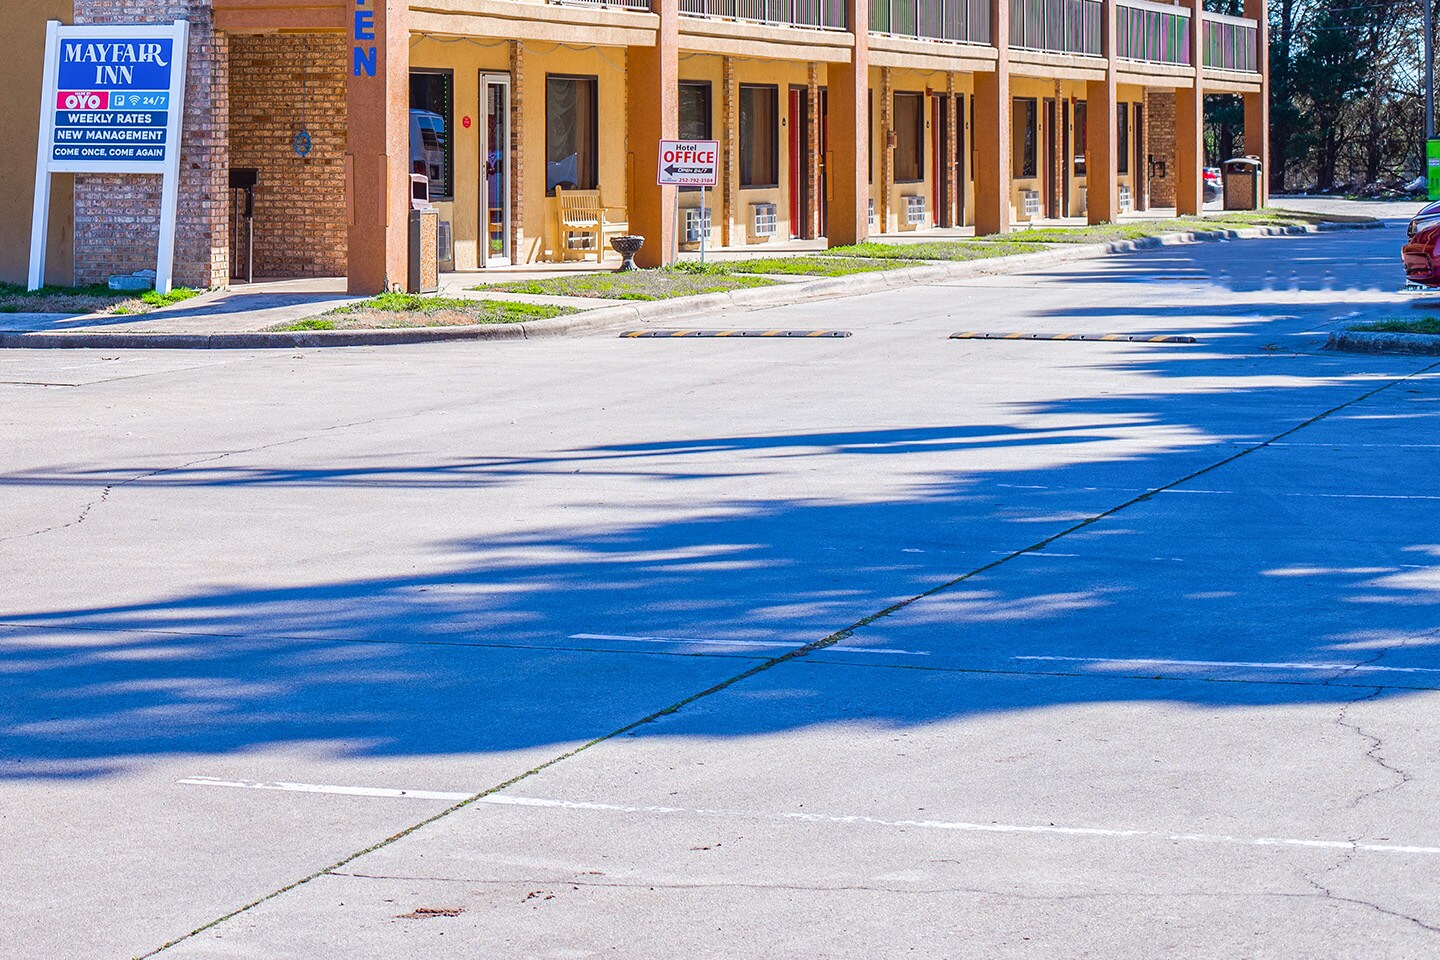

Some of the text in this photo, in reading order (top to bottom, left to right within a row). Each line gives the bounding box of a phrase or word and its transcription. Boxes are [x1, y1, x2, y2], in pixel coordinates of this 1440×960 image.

[64, 43, 168, 67] MAYFAIR
[94, 65, 134, 85] INN
[65, 95, 101, 109] OYO
[143, 96, 166, 106] 24/7
[68, 113, 152, 124] WEEKLY RATES
[57, 130, 163, 140] NEW MANAGEMENT
[54, 148, 163, 157] COME ONCE, COME AGAIN
[663, 151, 714, 163] OFFICE
